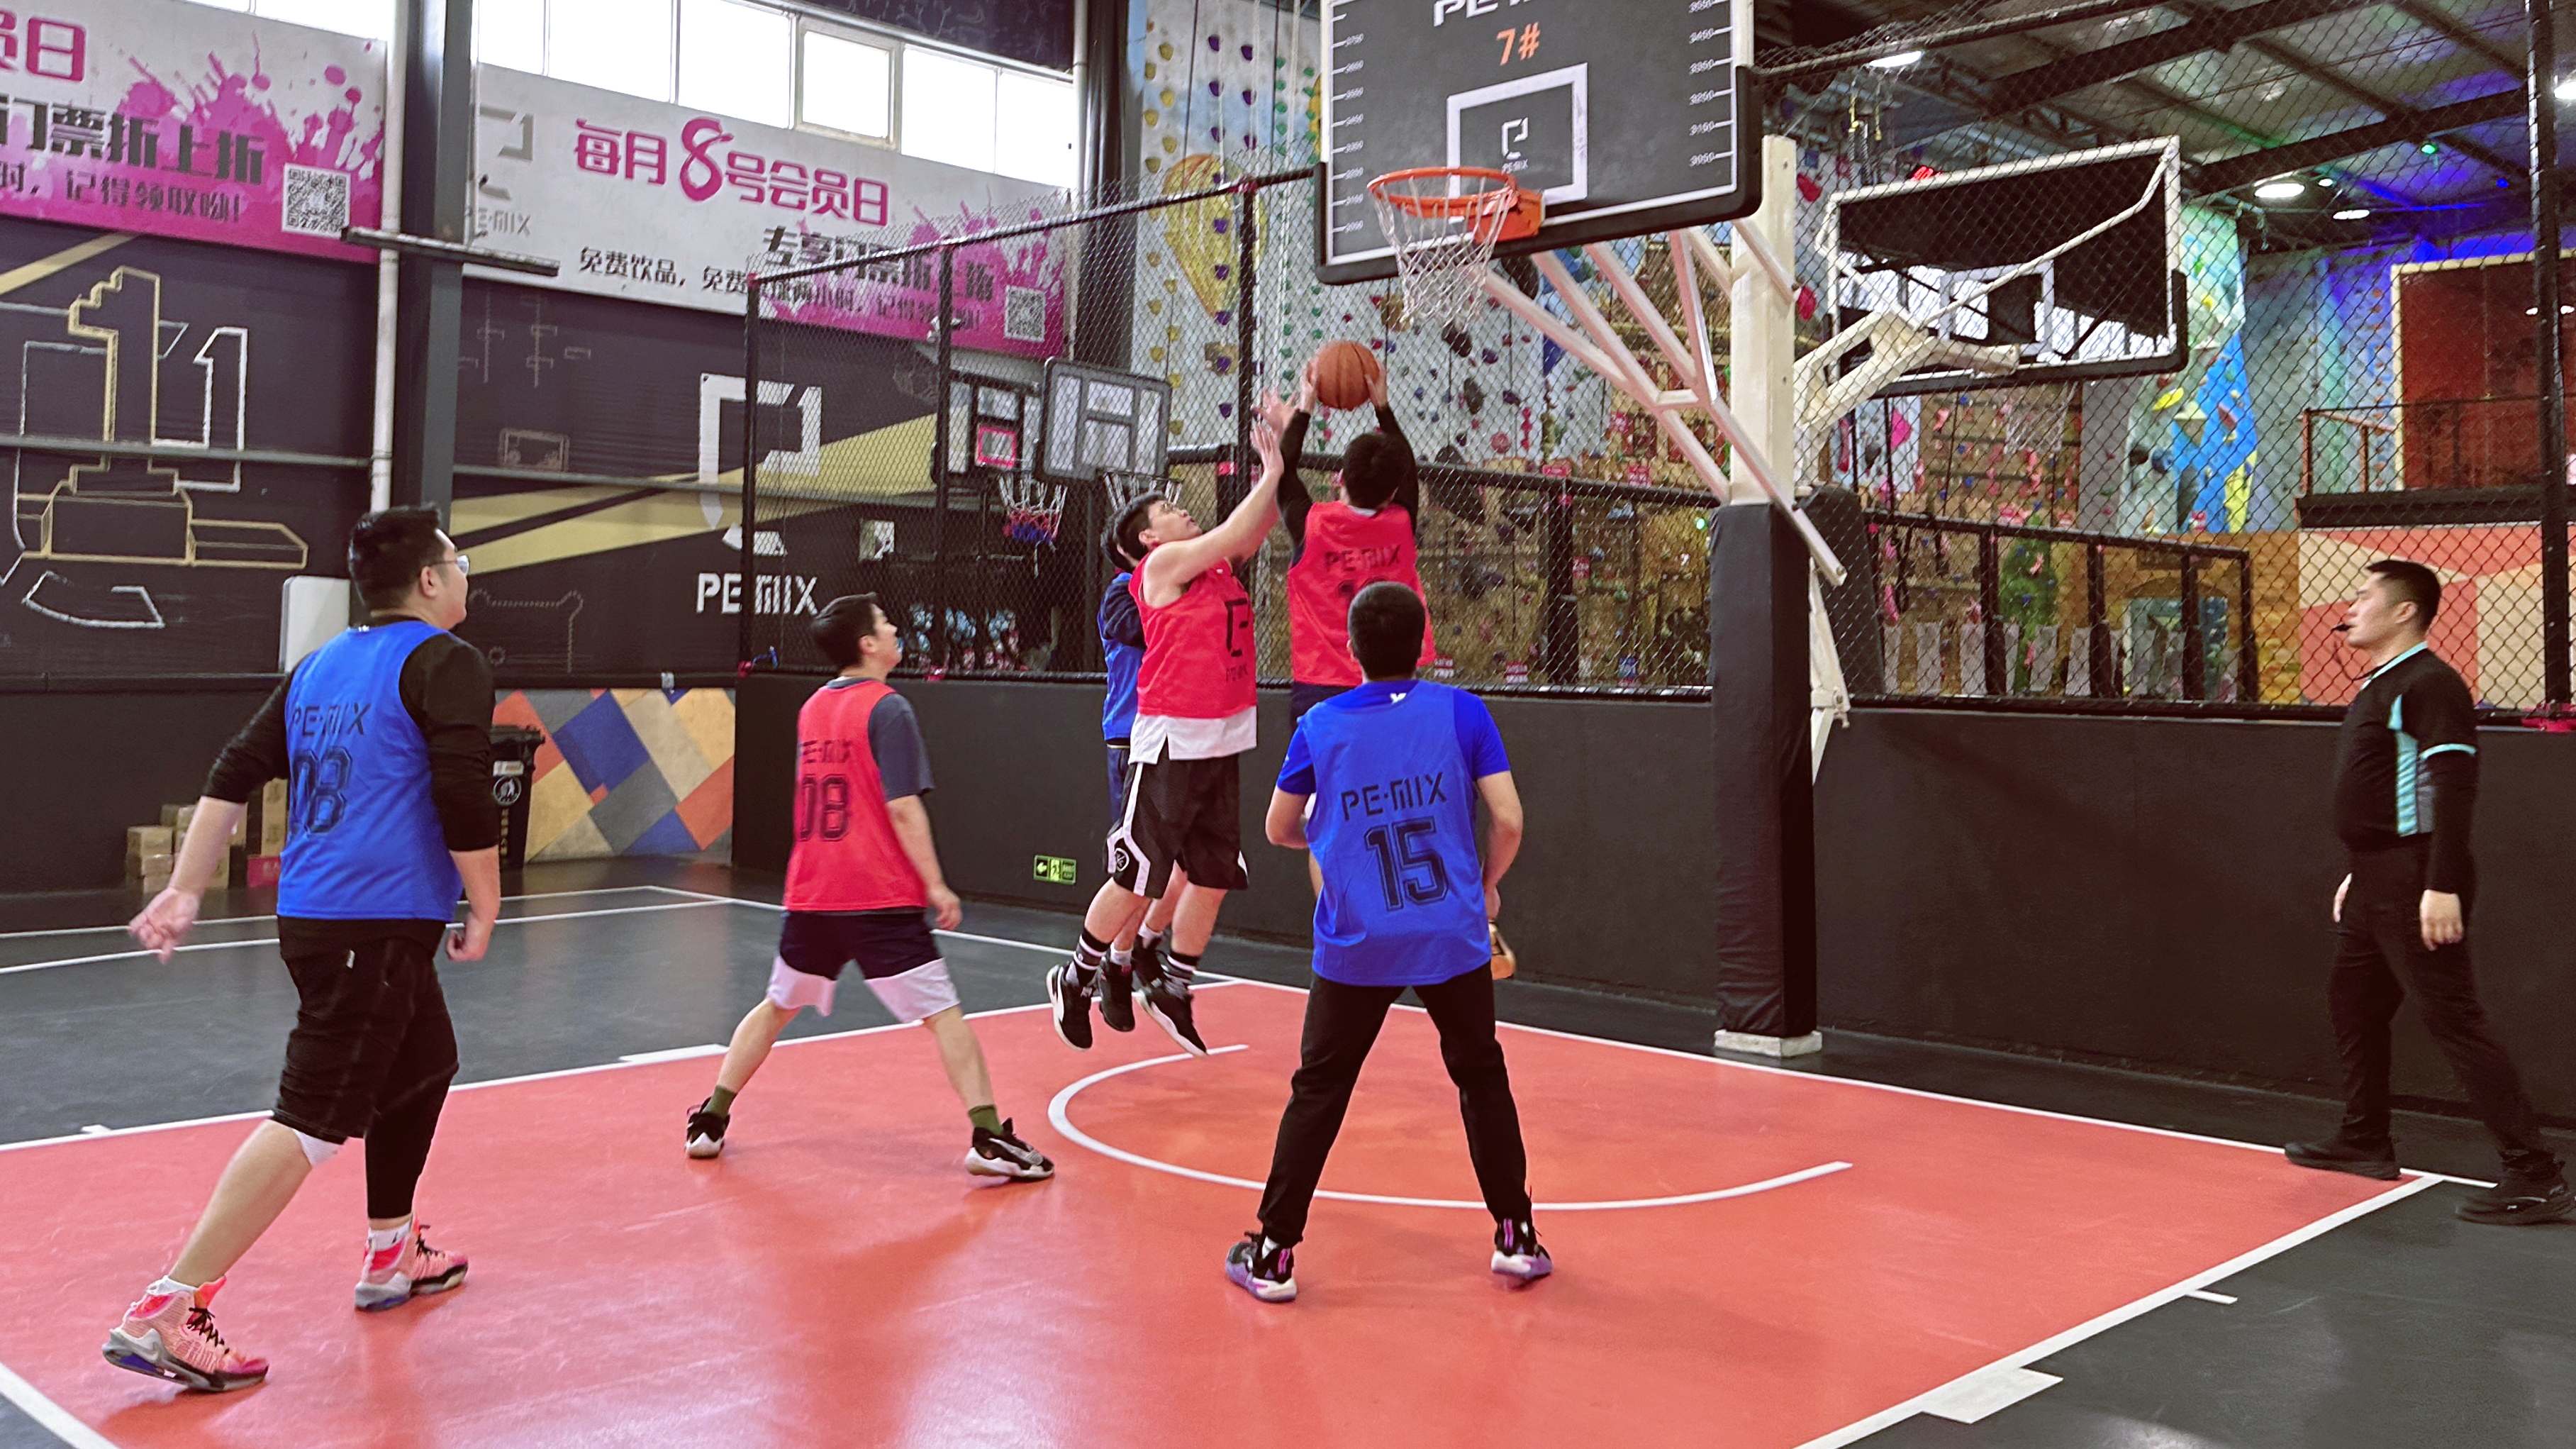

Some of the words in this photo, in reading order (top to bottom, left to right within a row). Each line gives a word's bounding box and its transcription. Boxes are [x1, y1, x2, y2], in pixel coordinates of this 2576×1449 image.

[0, 10, 86, 82] 日
[1495, 22, 1541, 65] 7#
[575, 116, 888, 226] 每月8号会员日
[1364, 816, 1450, 912] 15
